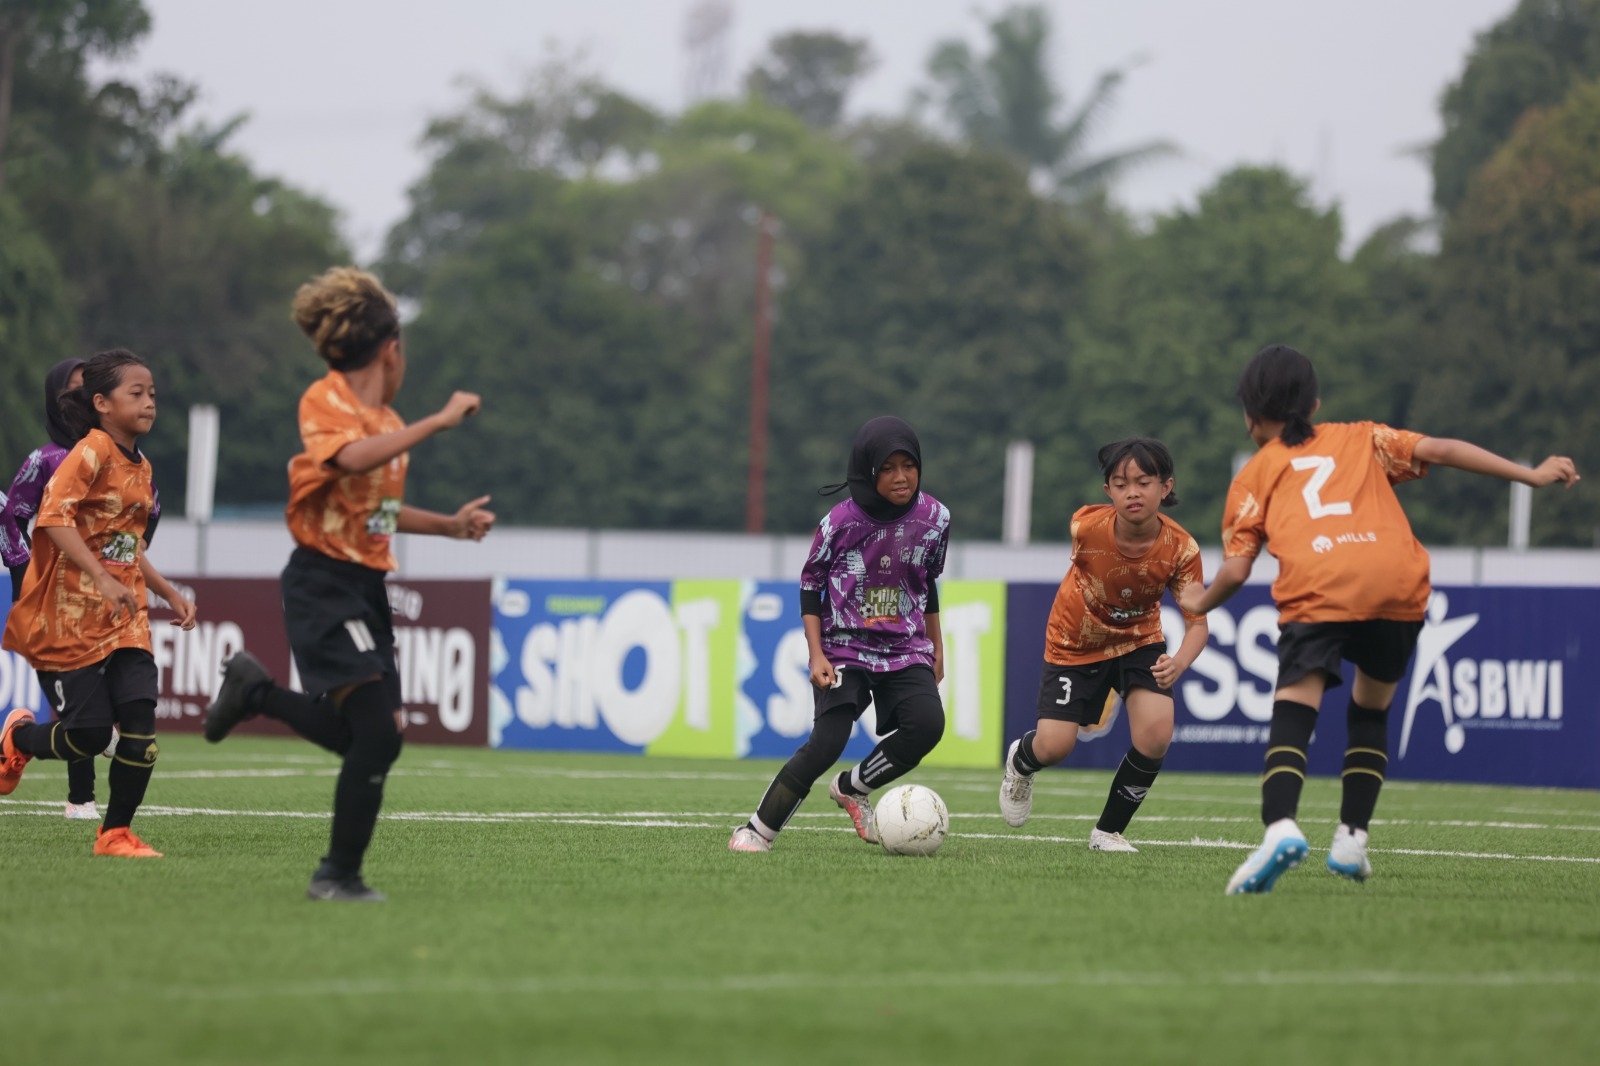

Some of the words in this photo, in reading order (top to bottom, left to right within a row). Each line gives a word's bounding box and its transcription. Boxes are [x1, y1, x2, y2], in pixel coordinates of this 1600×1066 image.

[1290, 455, 1353, 520] 2
[1336, 532, 1377, 544] MILLS
[870, 588, 898, 603] Milk
[874, 602, 897, 617] Life
[515, 589, 722, 747] SHOT
[54, 679, 67, 712] 9
[1056, 677, 1073, 704] 3
